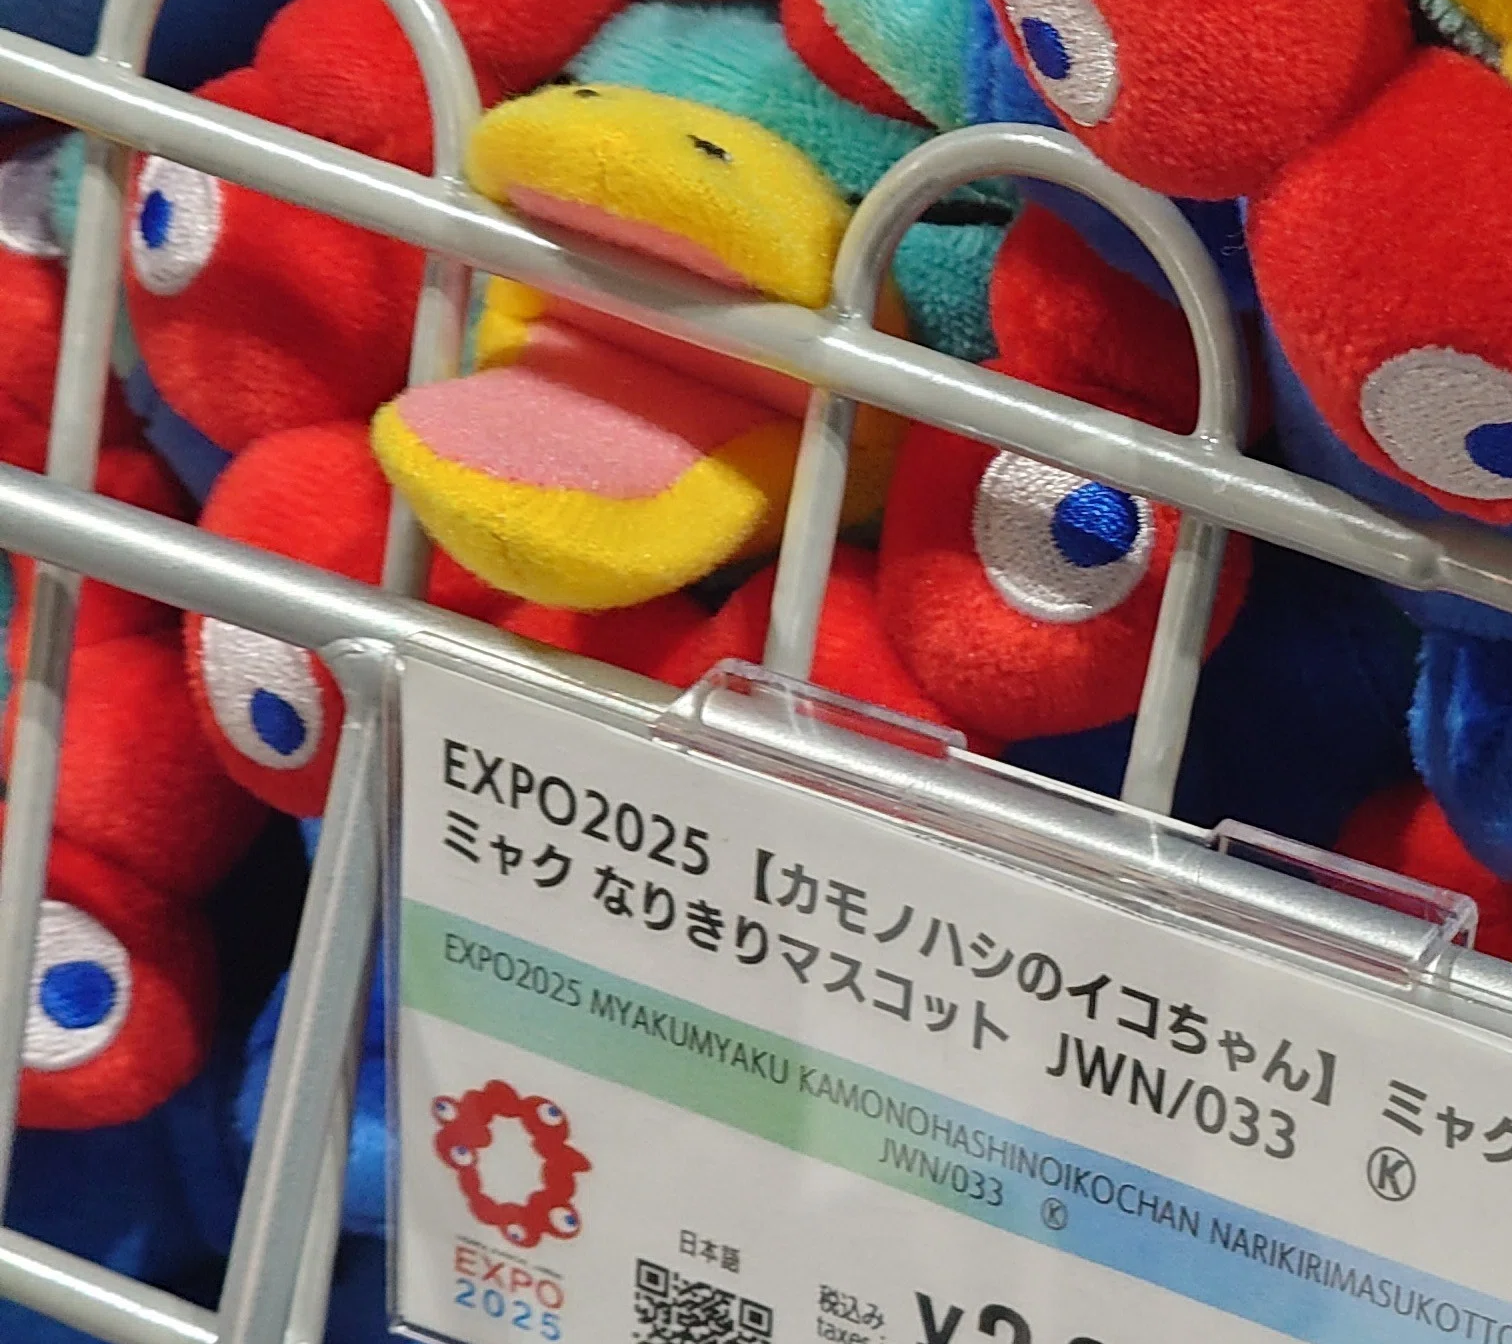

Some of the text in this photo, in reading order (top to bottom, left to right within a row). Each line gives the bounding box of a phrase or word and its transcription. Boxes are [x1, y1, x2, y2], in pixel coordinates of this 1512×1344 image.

[443, 738, 711, 876] EXPO2025
[754, 847, 1337, 1107] 【カモノハシのイコちゃん】
[443, 809, 573, 889] ミャク
[592, 863, 1010, 1051] なりきりマスコット
[1045, 1032, 1298, 1160] JWN/033
[444, 932, 583, 1008] EXPO2025
[590, 987, 790, 1085] MYAKUMYAKU
[798, 1063, 1201, 1238] KAMONOHASHINOIKOCHAN
[879, 1137, 1005, 1208] JWN/033
[454, 1245, 565, 1310] EXPO
[679, 1228, 742, 1274] 日本語
[454, 1277, 562, 1341] 2025
[817, 1284, 886, 1331] 税込み
